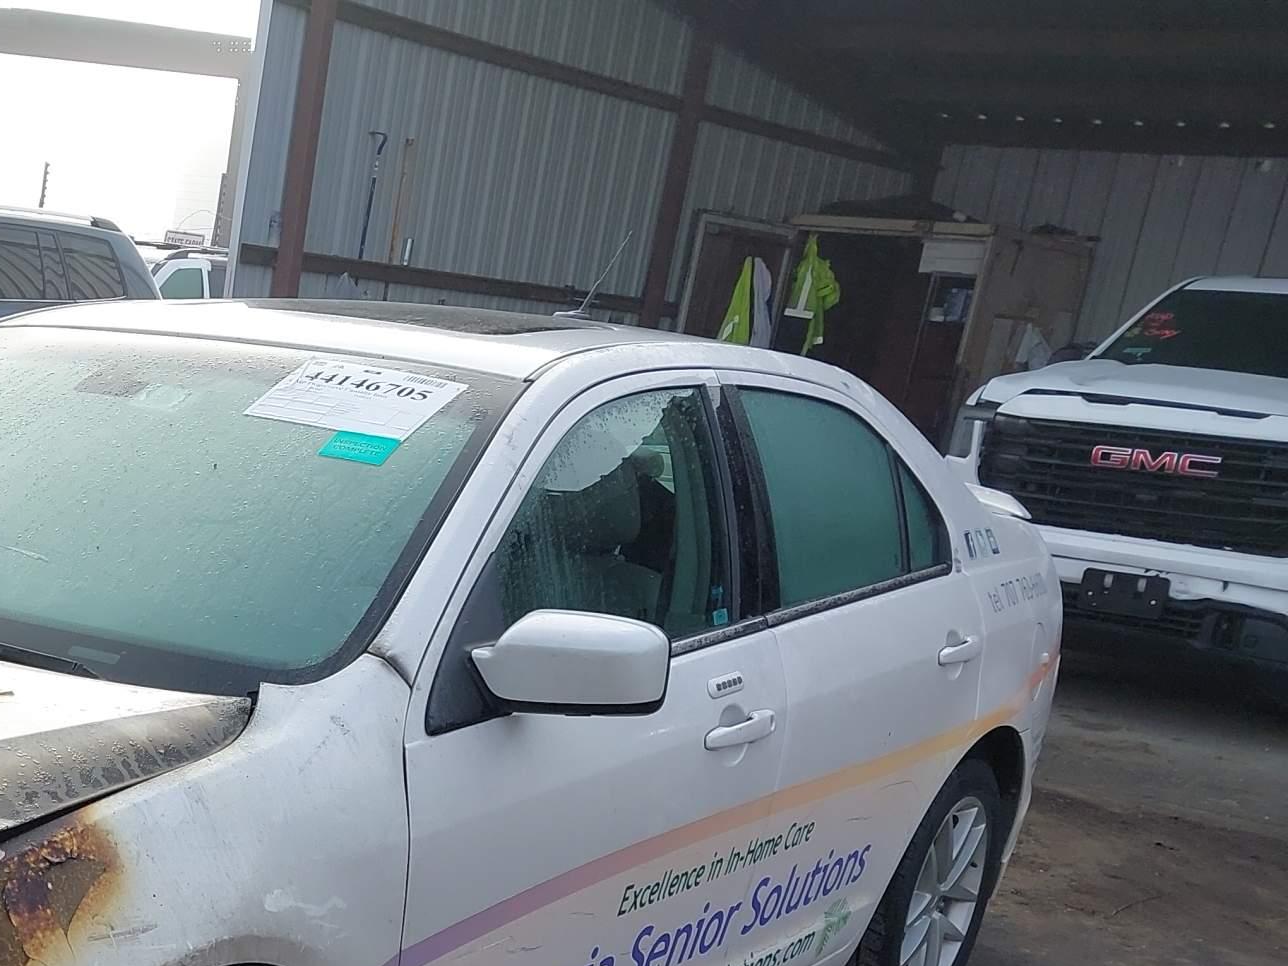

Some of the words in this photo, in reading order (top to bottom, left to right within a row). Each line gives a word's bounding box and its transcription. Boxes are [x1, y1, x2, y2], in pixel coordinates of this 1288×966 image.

[305, 371, 433, 401] 44146705
[333, 438, 387, 451] INSPECTION
[1091, 445, 1223, 478] GMC
[617, 867, 706, 917] Excellence
[707, 851, 724, 883] in
[724, 834, 783, 874] In-Home
[784, 820, 816, 852] Care
[741, 843, 872, 935] Solutions
